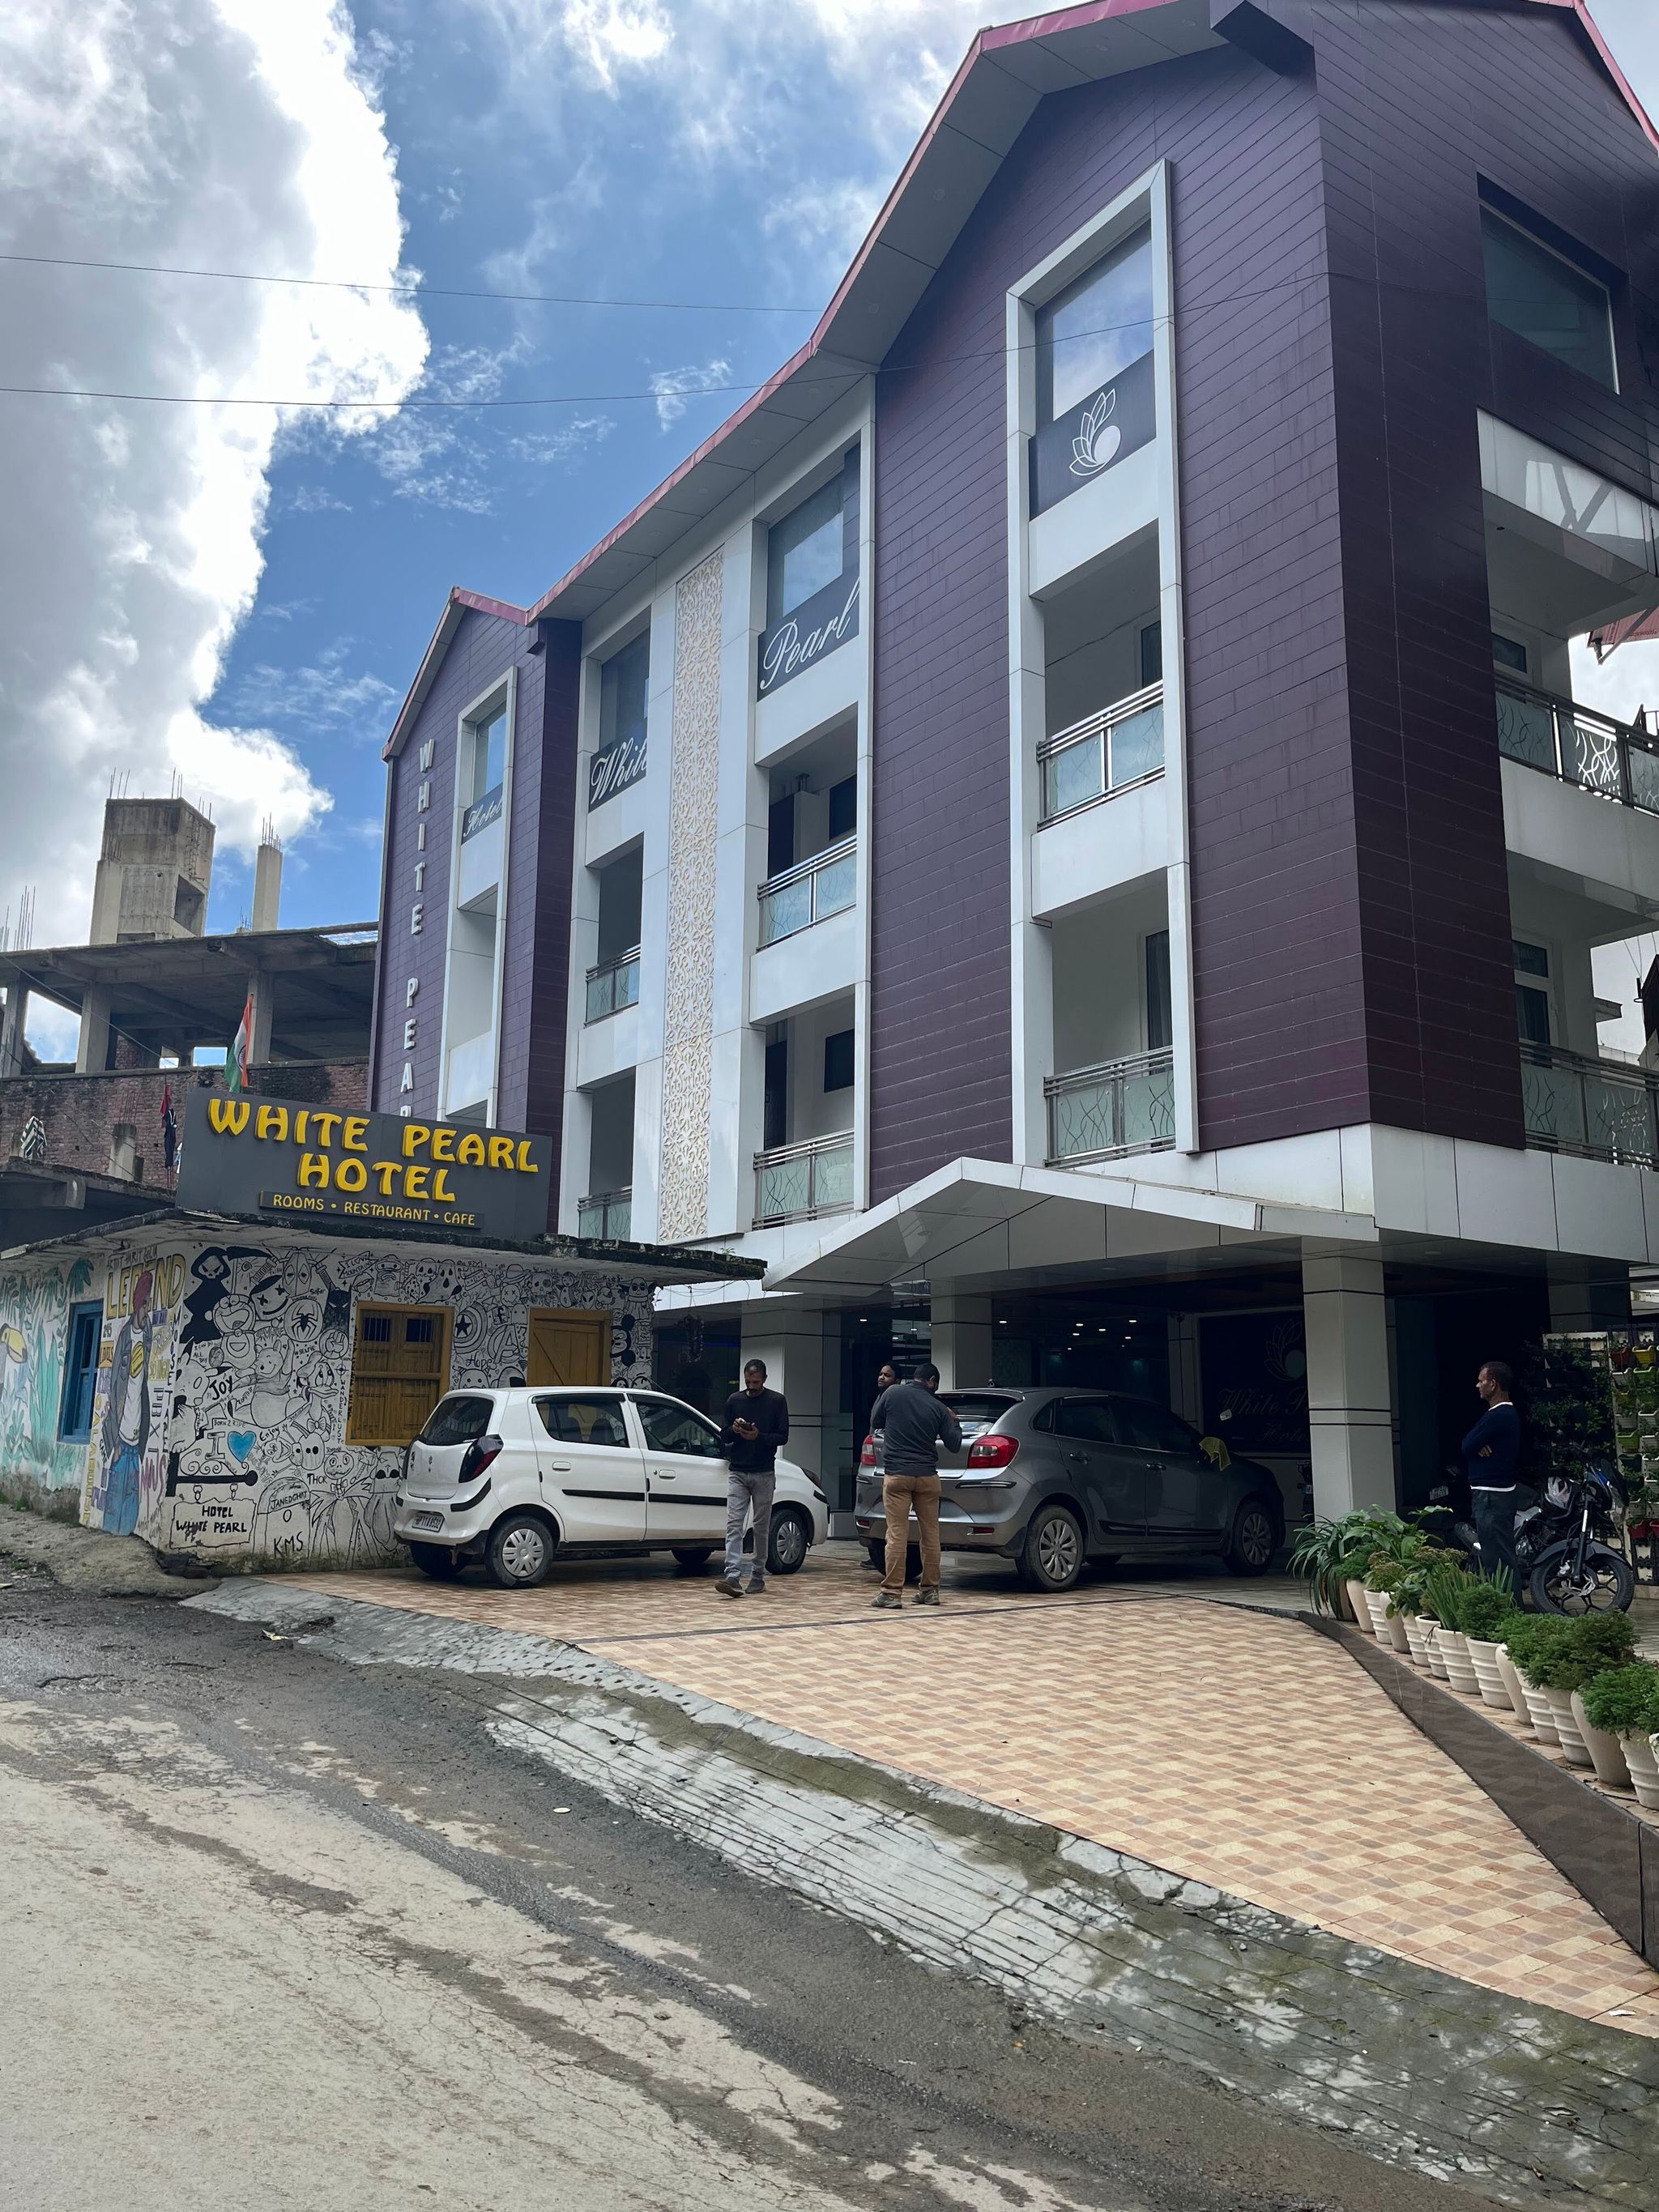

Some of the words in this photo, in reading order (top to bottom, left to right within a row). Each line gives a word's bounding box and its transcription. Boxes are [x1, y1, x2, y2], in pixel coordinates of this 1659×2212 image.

[760, 577, 859, 690] Pearl
[410, 739, 436, 935] WHITE
[207, 1098, 371, 1152] WHITE
[401, 1124, 539, 1174] PEARL
[297, 1153, 455, 1202] HOTEL
[273, 1194, 324, 1211] ROOMS
[344, 1201, 431, 1221] RESTAURANT
[444, 1212, 475, 1225] CAFE
[209, 1375, 232, 1400] JOY
[337, 1379, 346, 1444] WANDERLUST
[259, 1426, 280, 1441] Enjoy
[202, 1505, 234, 1519] HOTEL
[214, 1522, 247, 1533] PEARL
[273, 1531, 304, 1560] KMS
